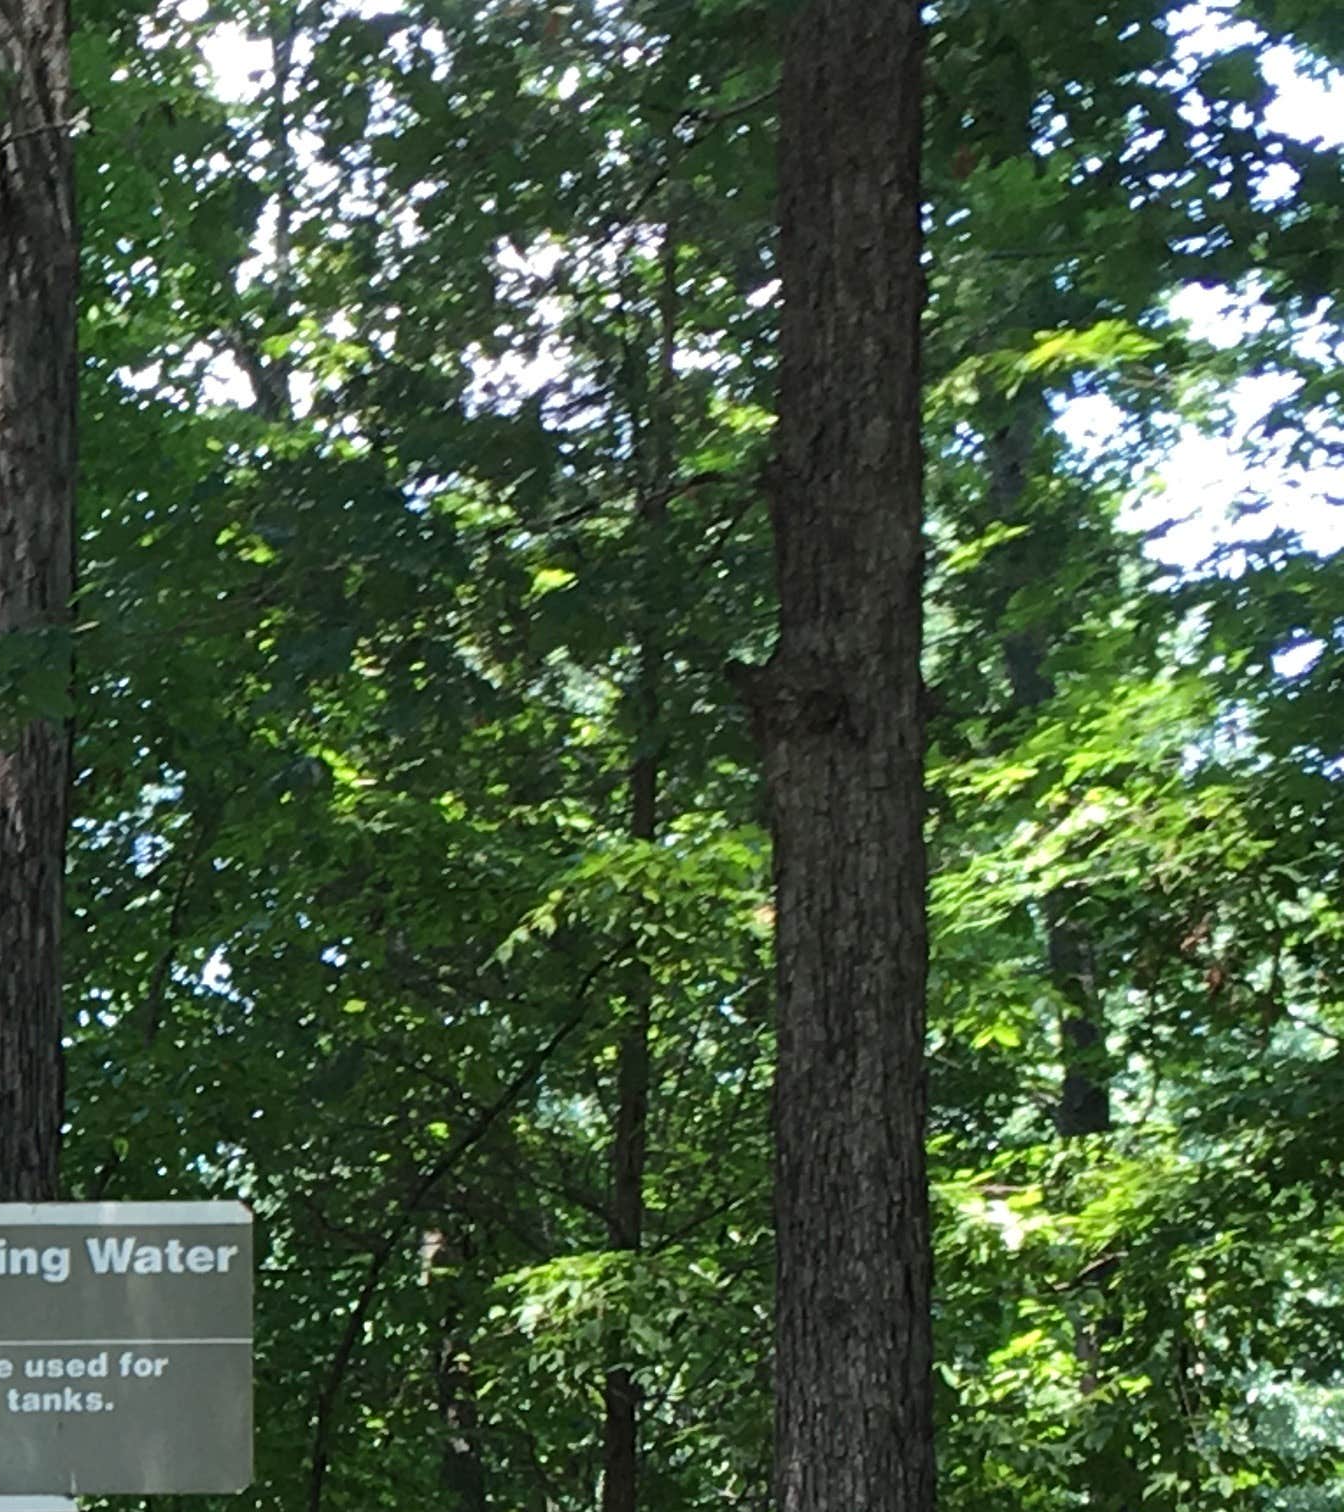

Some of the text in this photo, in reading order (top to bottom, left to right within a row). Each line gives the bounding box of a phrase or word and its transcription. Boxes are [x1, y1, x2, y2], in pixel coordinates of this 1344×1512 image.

[86, 1236, 238, 1274] Water
[24, 1353, 108, 1378] used
[120, 1352, 168, 1377] for
[6, 1388, 114, 1412] tanks.
